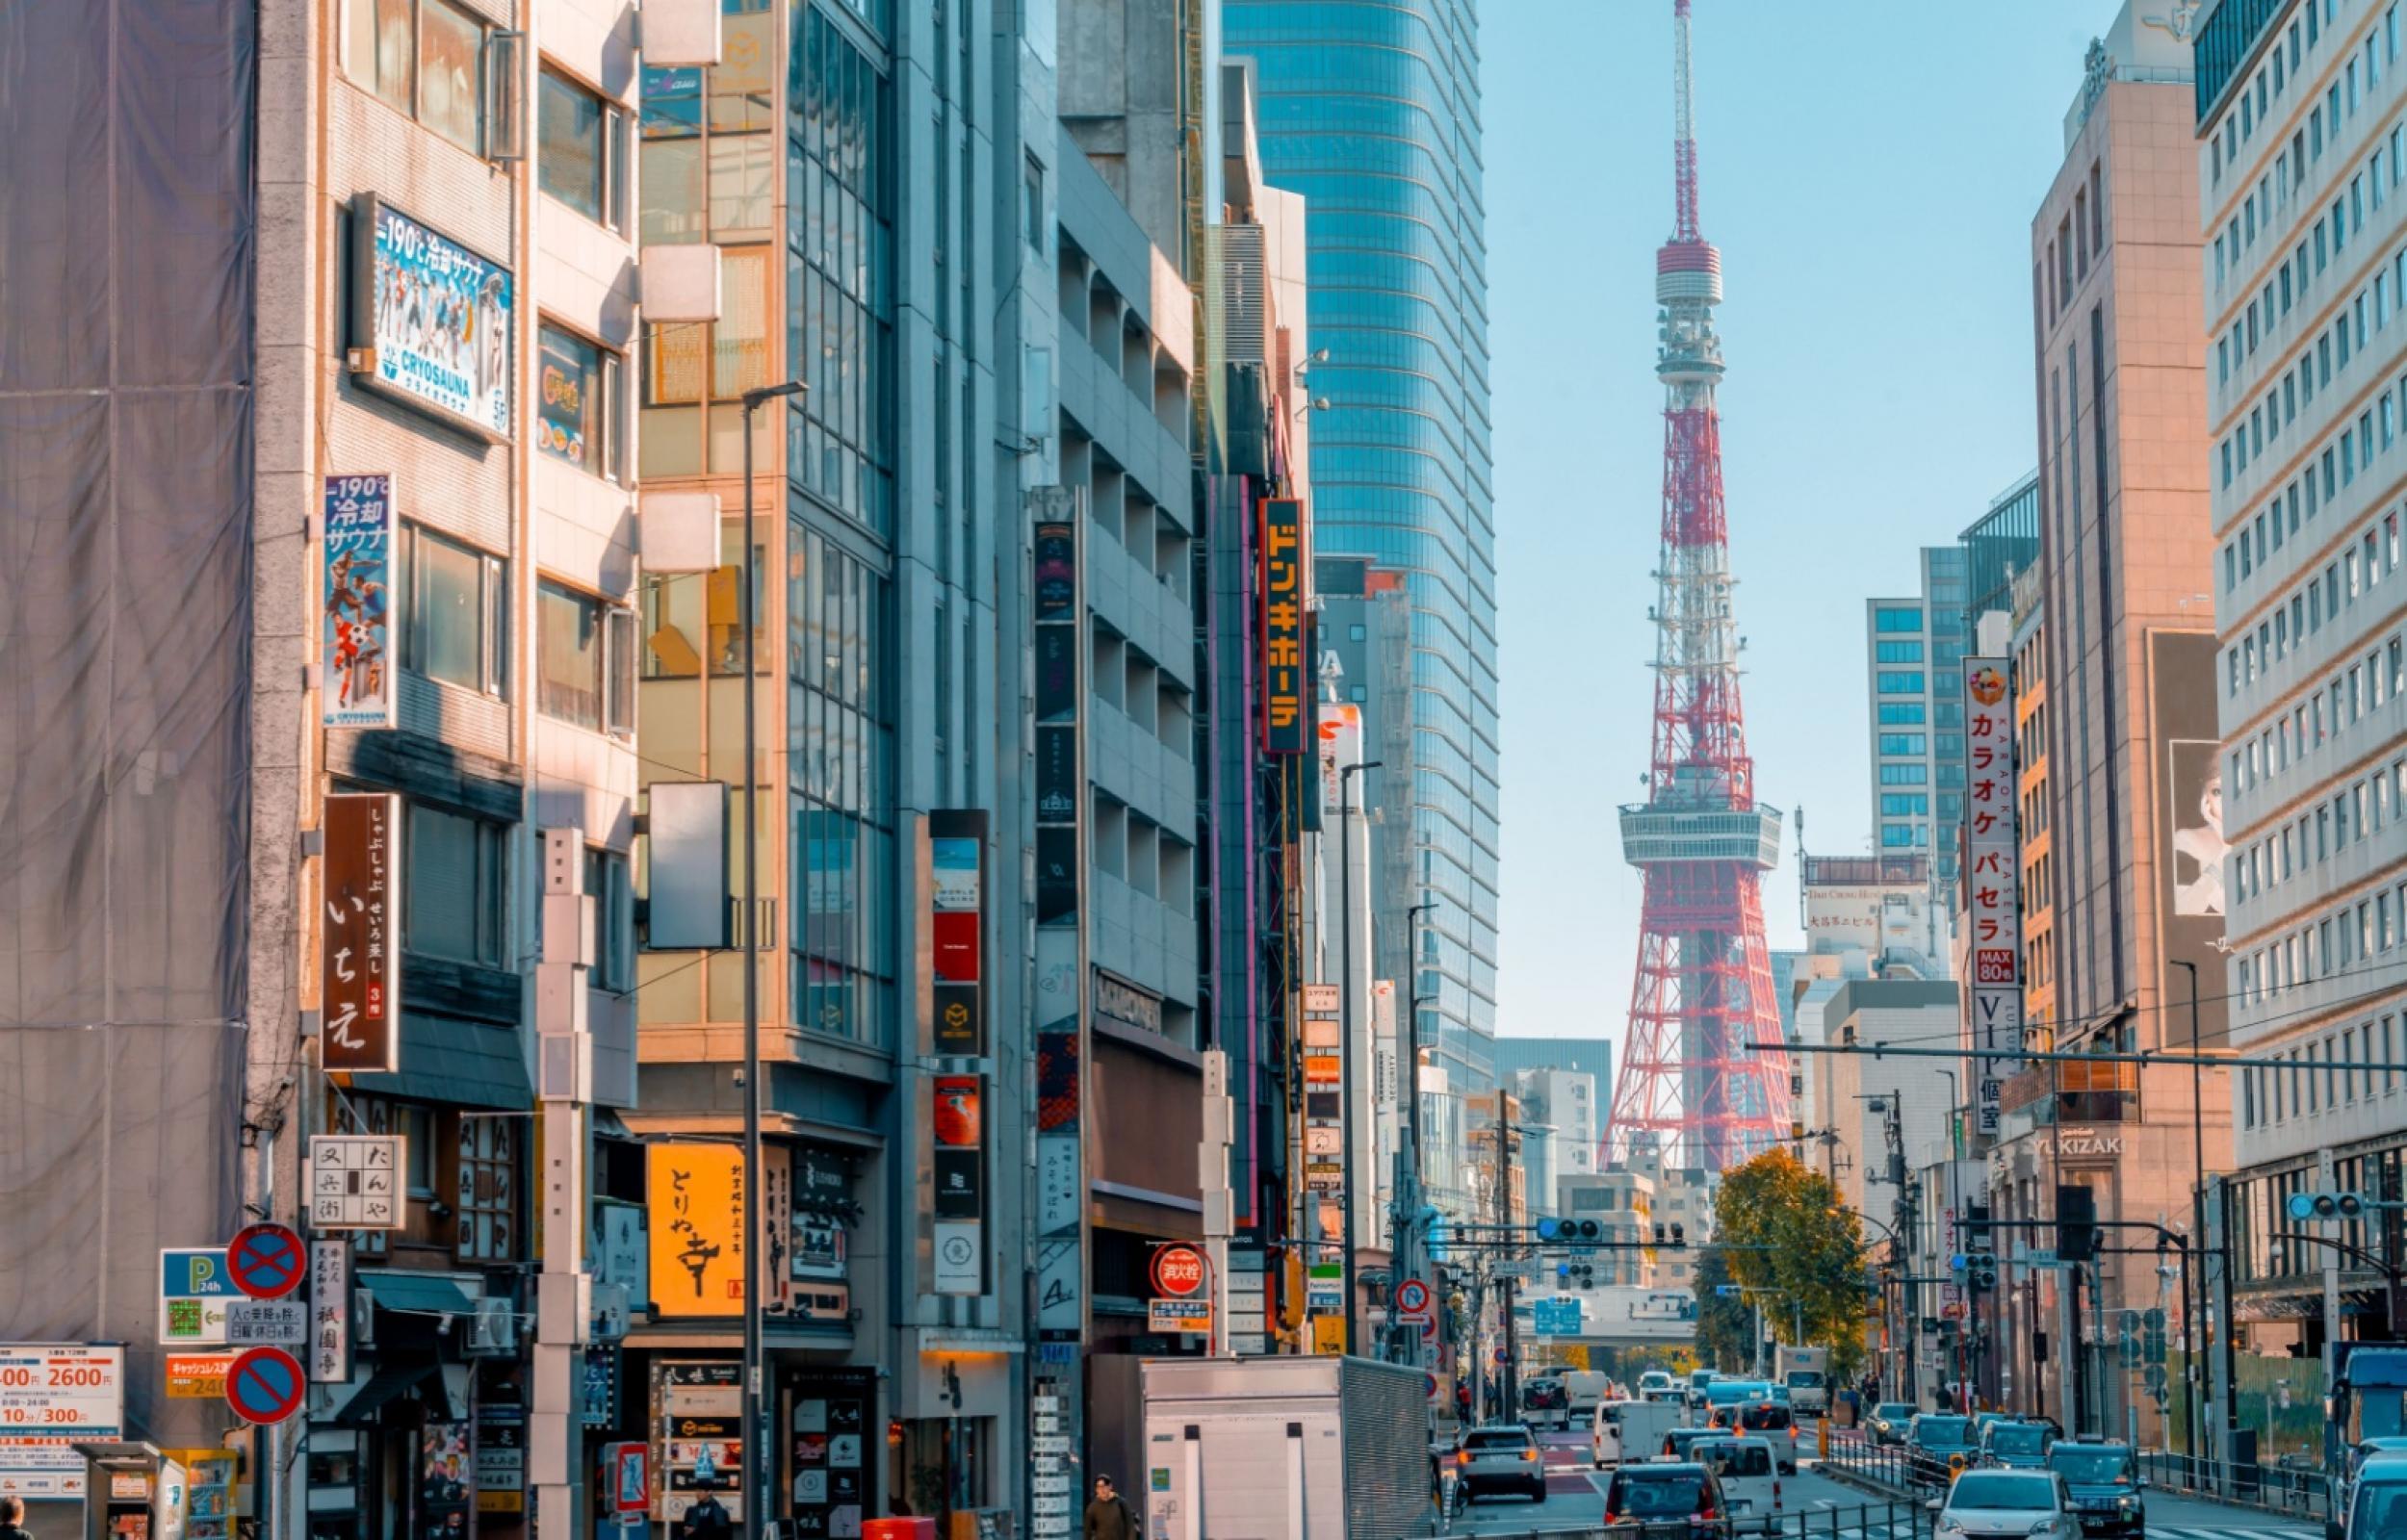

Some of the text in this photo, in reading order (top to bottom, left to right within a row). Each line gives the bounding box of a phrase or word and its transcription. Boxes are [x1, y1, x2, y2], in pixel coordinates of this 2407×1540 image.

[401, 348, 470, 398] CRYOSAUNA
[331, 500, 383, 526] 冷却
[325, 526, 389, 552] サウナ
[1971, 714, 1998, 834] カラオケ
[1998, 717, 2011, 828] KARAOKE
[369, 808, 384, 892] しゃぶしゃぶ
[1975, 852, 2001, 941] パセラ
[2002, 857, 2013, 937] PASELA
[1980, 951, 2010, 962] MAX
[1980, 963, 2012, 981] 80名
[1980, 1079, 2001, 1129] 個室
[189, 1255, 214, 1295] P
[199, 1282, 221, 1293] 24h
[1163, 1263, 1200, 1280] 消火栓
[0, 1368, 40, 1386] 00円
